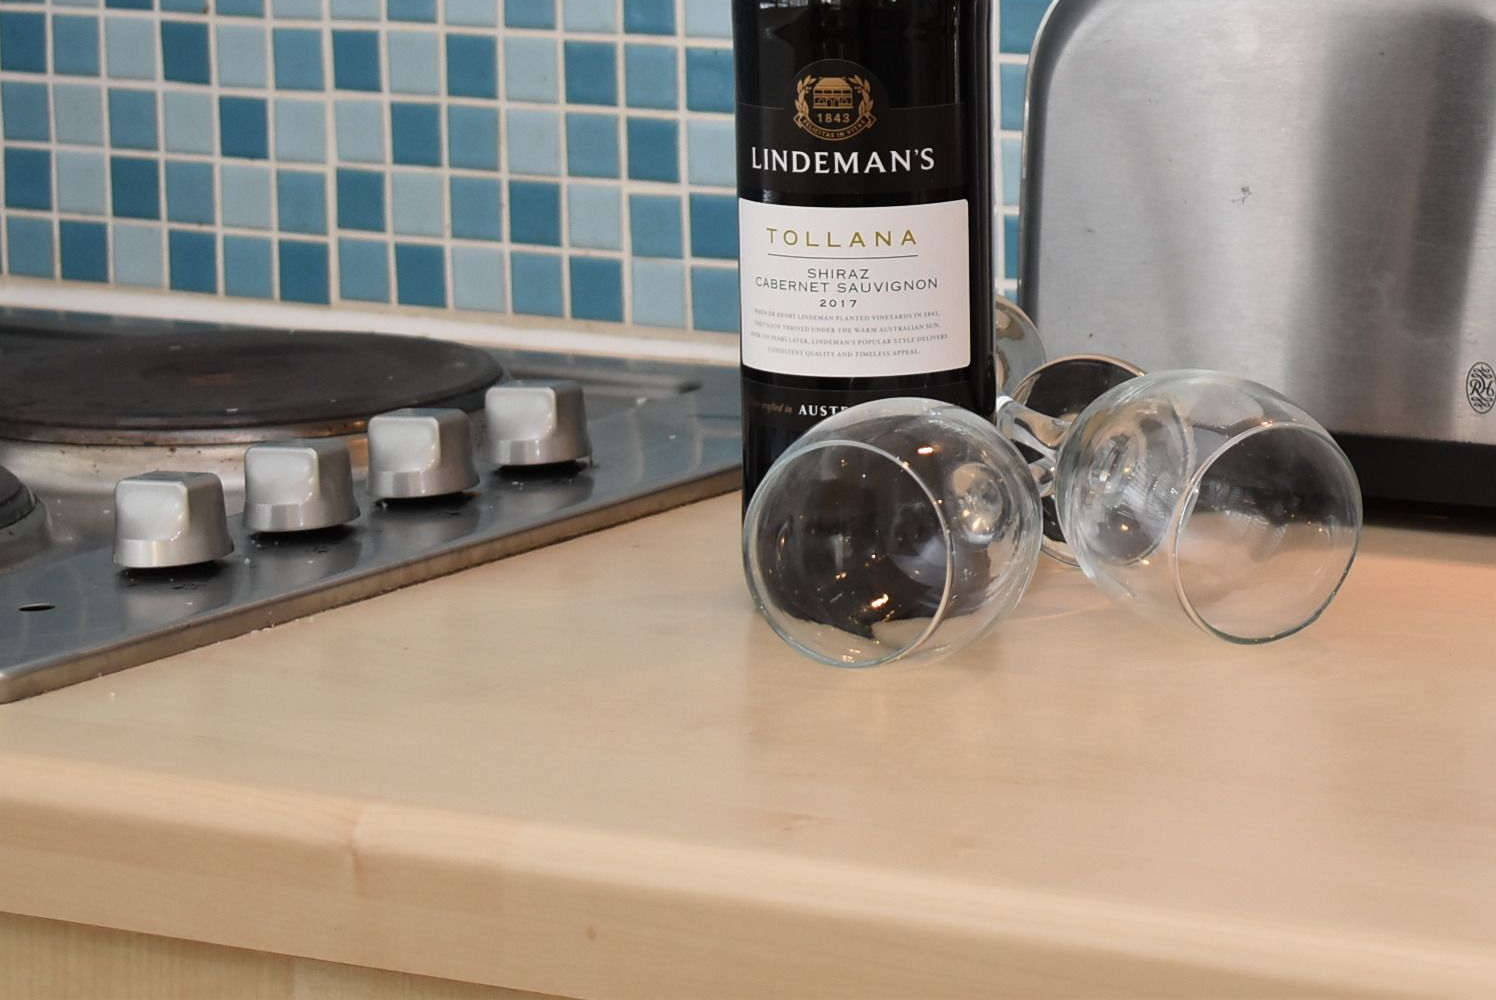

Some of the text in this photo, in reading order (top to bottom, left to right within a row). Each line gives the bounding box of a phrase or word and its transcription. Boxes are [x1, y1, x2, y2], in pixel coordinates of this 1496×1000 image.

[816, 112, 851, 124] 1843
[751, 146, 936, 174] LINDEMAN'S
[766, 227, 918, 248] TOLLANA
[807, 268, 871, 280] SHIRAZ
[755, 276, 939, 293] CABERNET SAUVIGNON
[819, 299, 858, 308] 2017
[797, 313, 834, 321] LINDEMAN
[871, 313, 912, 321] VINEYARDS
[914, 311, 922, 319] IN
[783, 324, 810, 332] THRIVED
[879, 324, 924, 332] AUSTRALIAN
[893, 336, 914, 345] STYLE
[805, 350, 834, 358] QUALITY
[854, 350, 891, 358] TIMELESS
